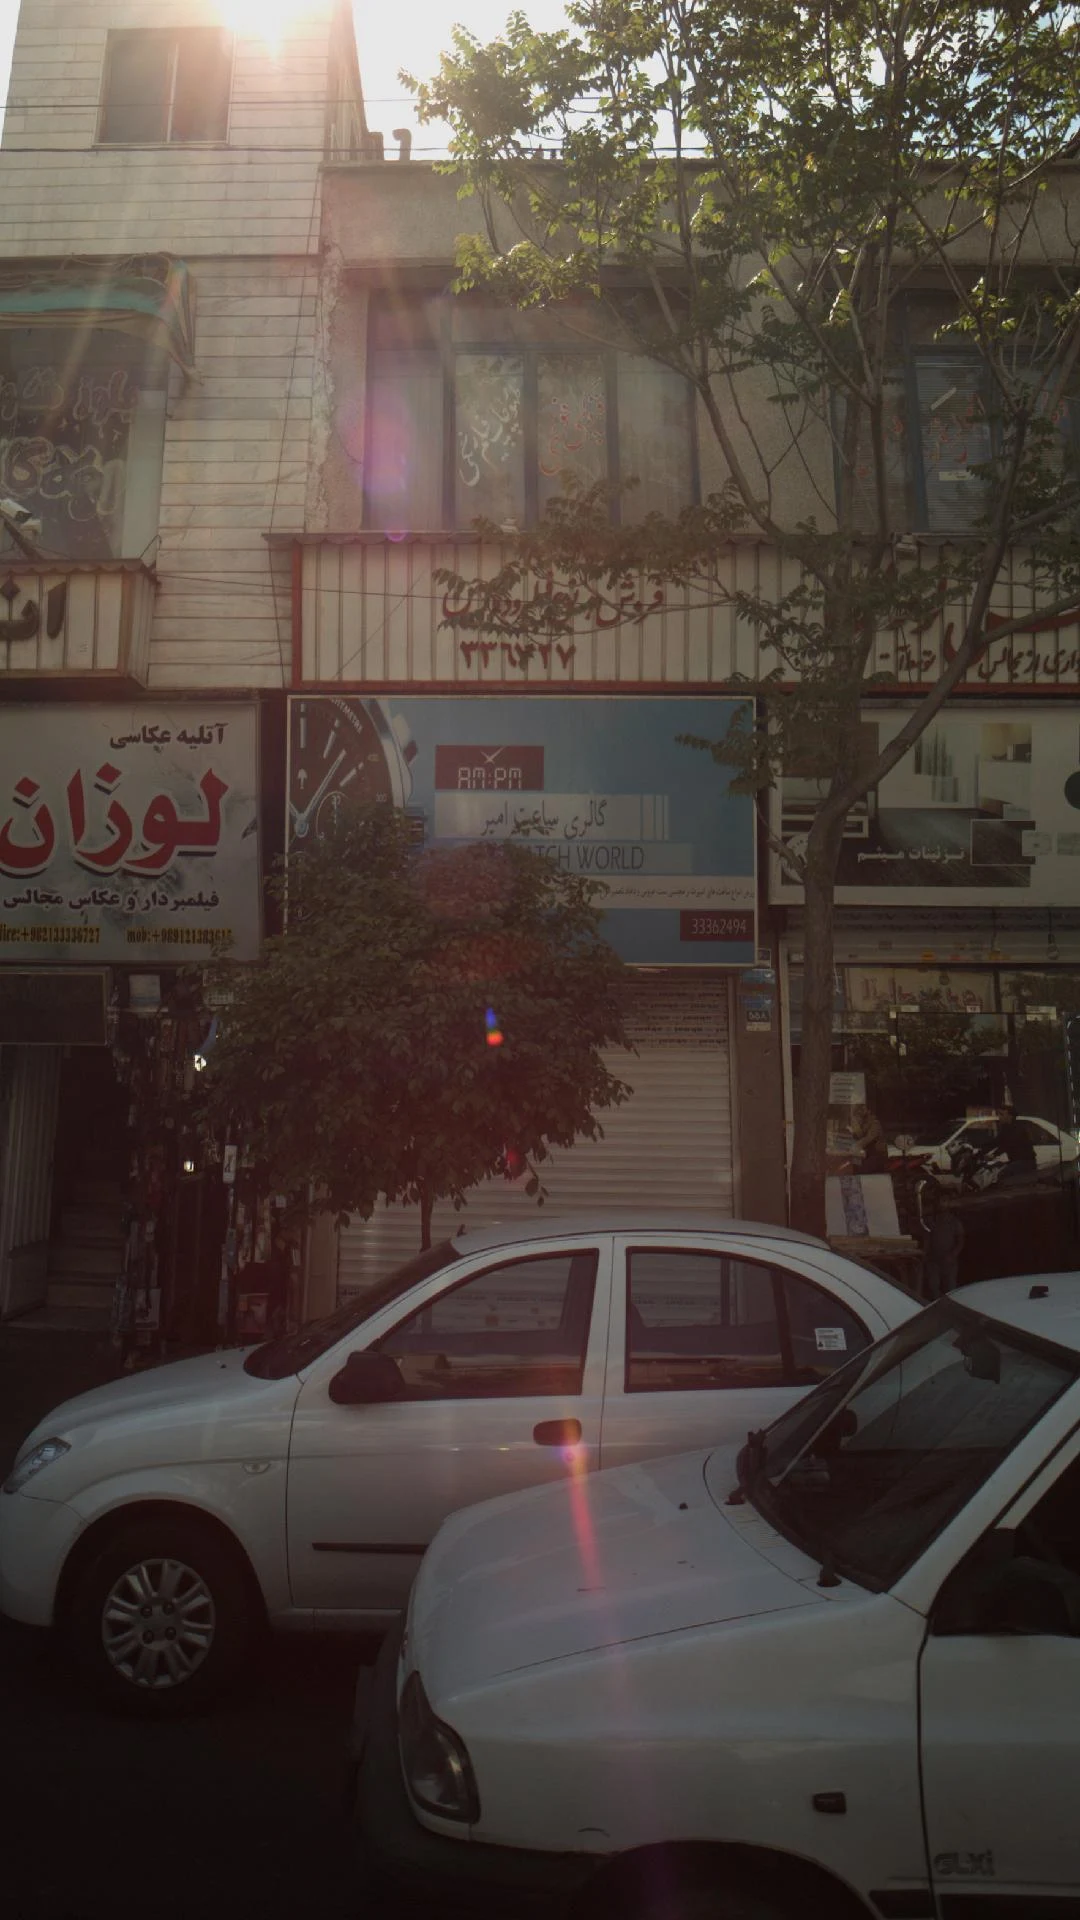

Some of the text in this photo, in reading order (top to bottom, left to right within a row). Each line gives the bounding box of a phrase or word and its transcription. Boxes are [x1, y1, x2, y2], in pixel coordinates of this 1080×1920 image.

[110, 722, 229, 750] آتلیه عکاسی
[0, 761, 229, 870] لوزان
[480, 799, 608, 840] گالری ساعت امیر
[576, 845, 645, 870] WORLD
[3, 888, 64, 910] مجالس
[144, 890, 220, 912] فیلمبردار
[690, 917, 747, 935] 33362494
